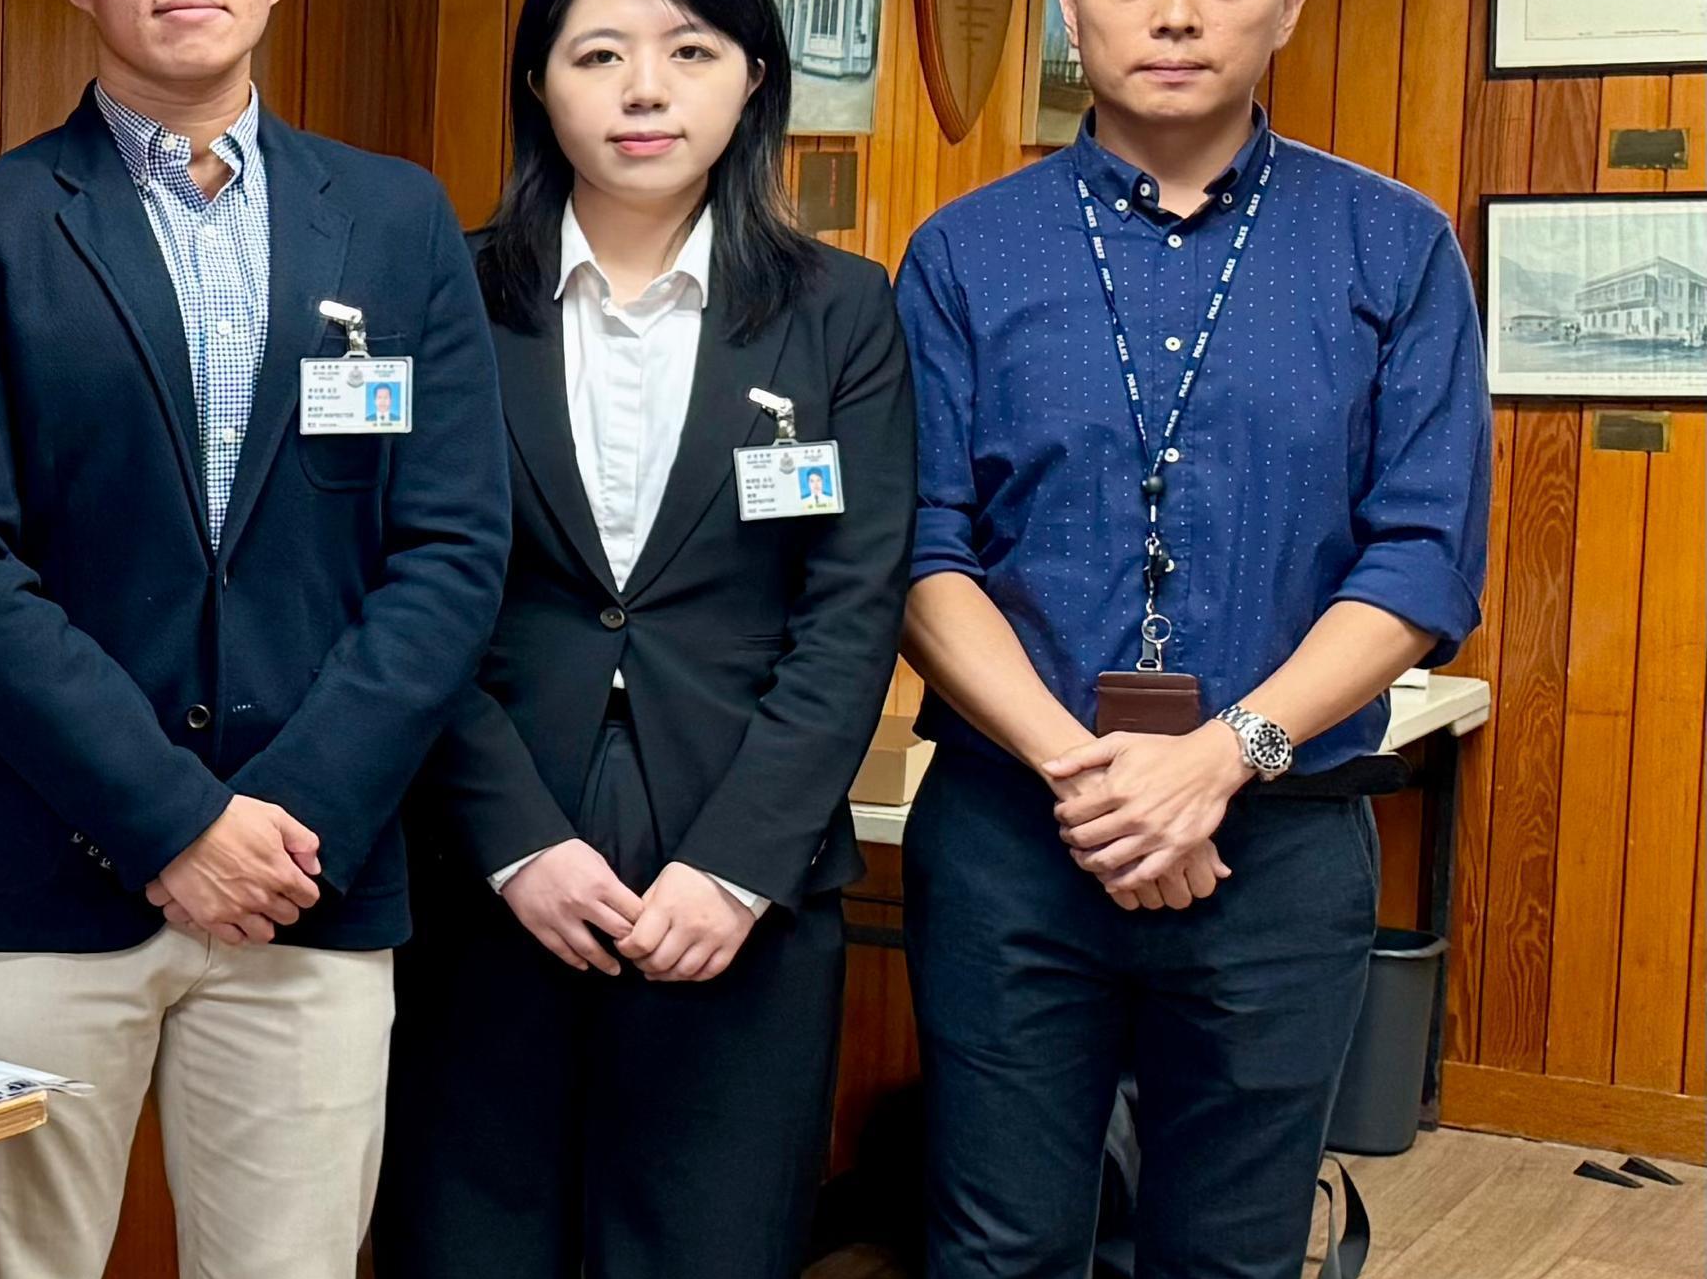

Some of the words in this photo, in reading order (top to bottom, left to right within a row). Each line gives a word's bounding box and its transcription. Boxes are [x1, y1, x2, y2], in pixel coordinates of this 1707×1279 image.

[1092, 236, 1106, 260] POLICE
[1233, 225, 1249, 250] POLICE
[1220, 258, 1237, 283] POLICE
[1206, 293, 1224, 321] POLICE
[1116, 334, 1130, 363] POLICE
[1191, 331, 1209, 359] POLICE
[1126, 373, 1140, 401] POLICE
